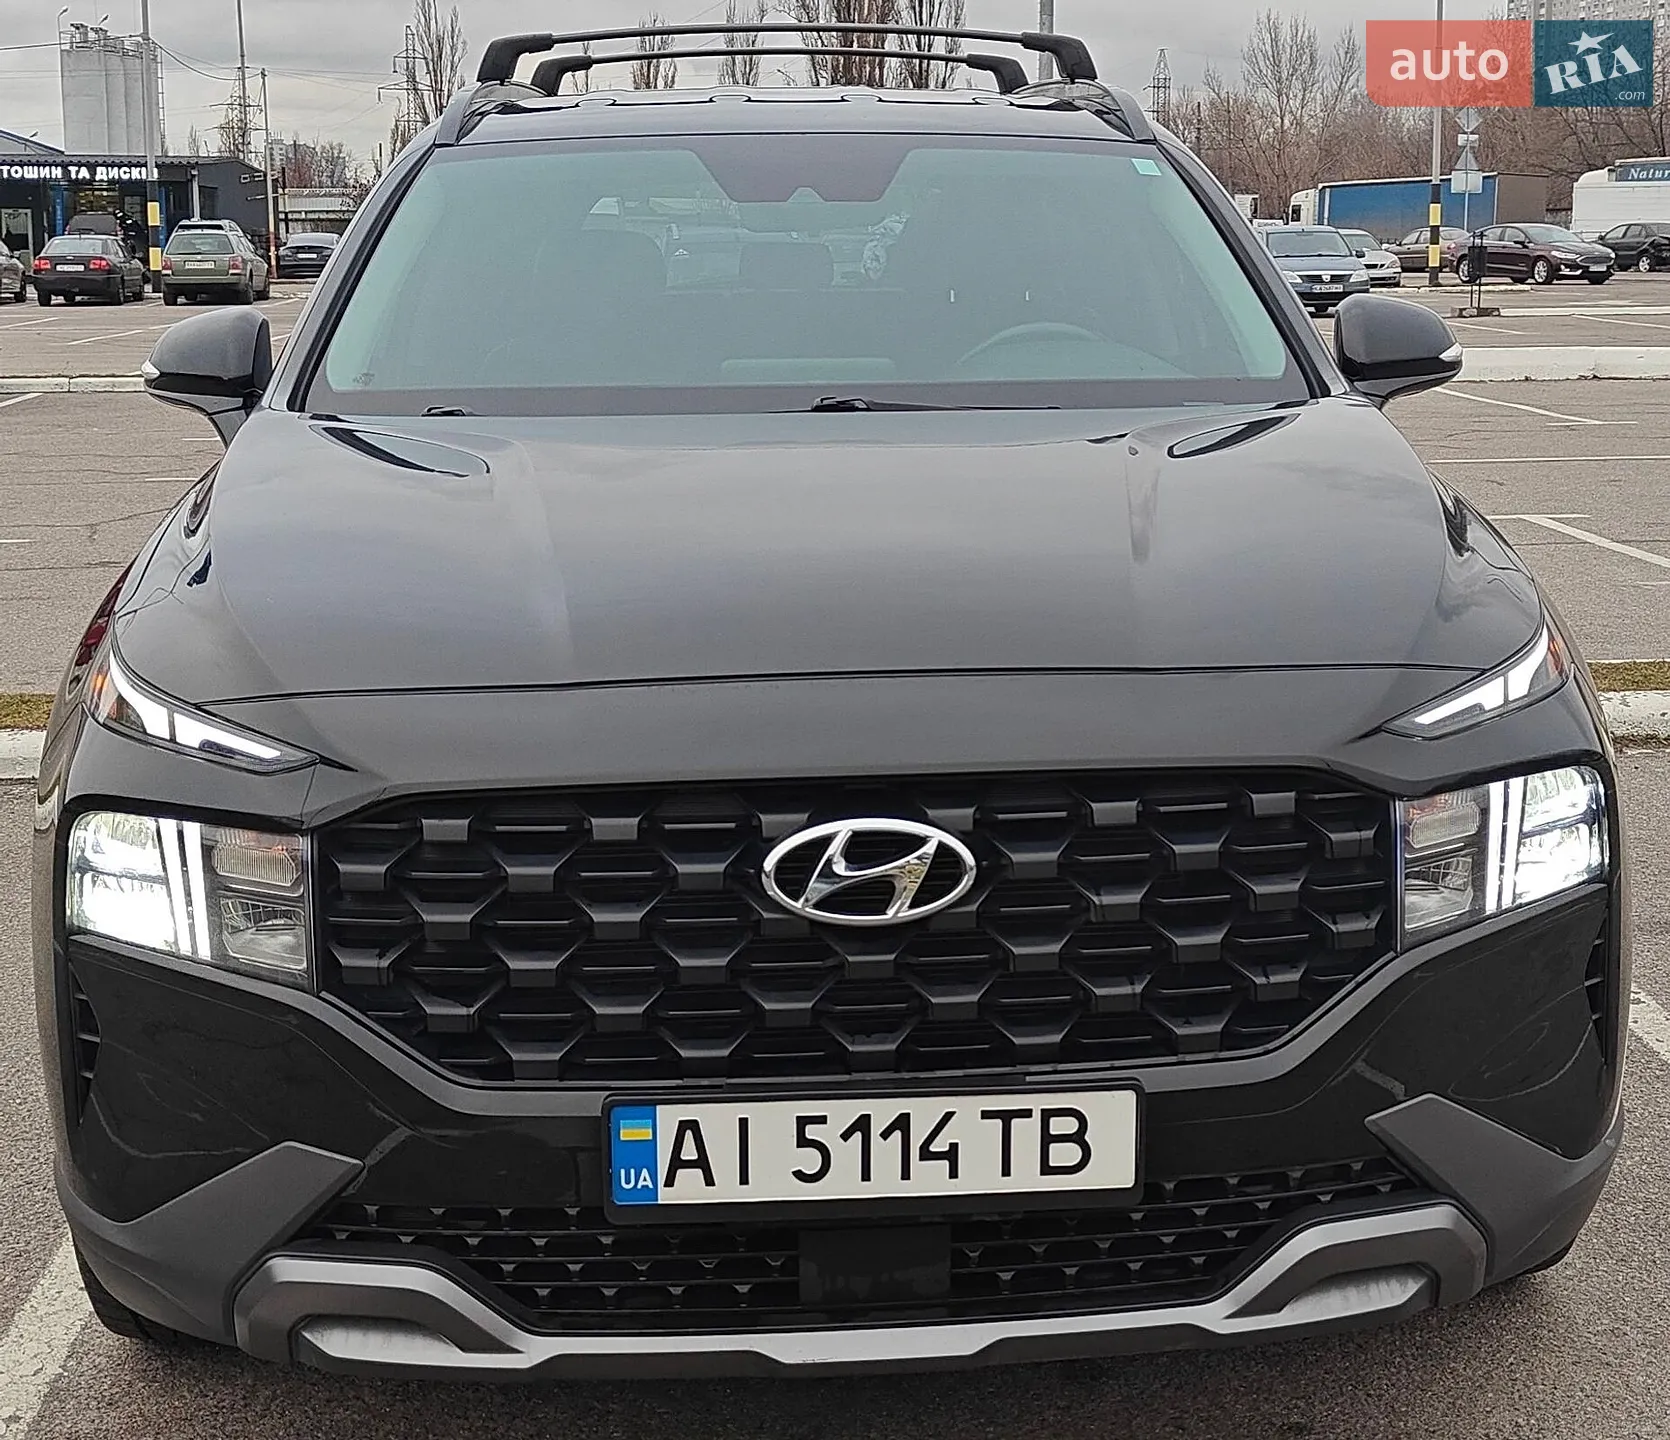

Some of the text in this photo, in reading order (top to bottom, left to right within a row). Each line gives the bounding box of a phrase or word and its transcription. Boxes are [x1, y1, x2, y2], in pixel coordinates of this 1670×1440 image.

[68, 166, 90, 180] ТА
[663, 1107, 1092, 1188] AI 5114 TB
[619, 1168, 653, 1190] UA
